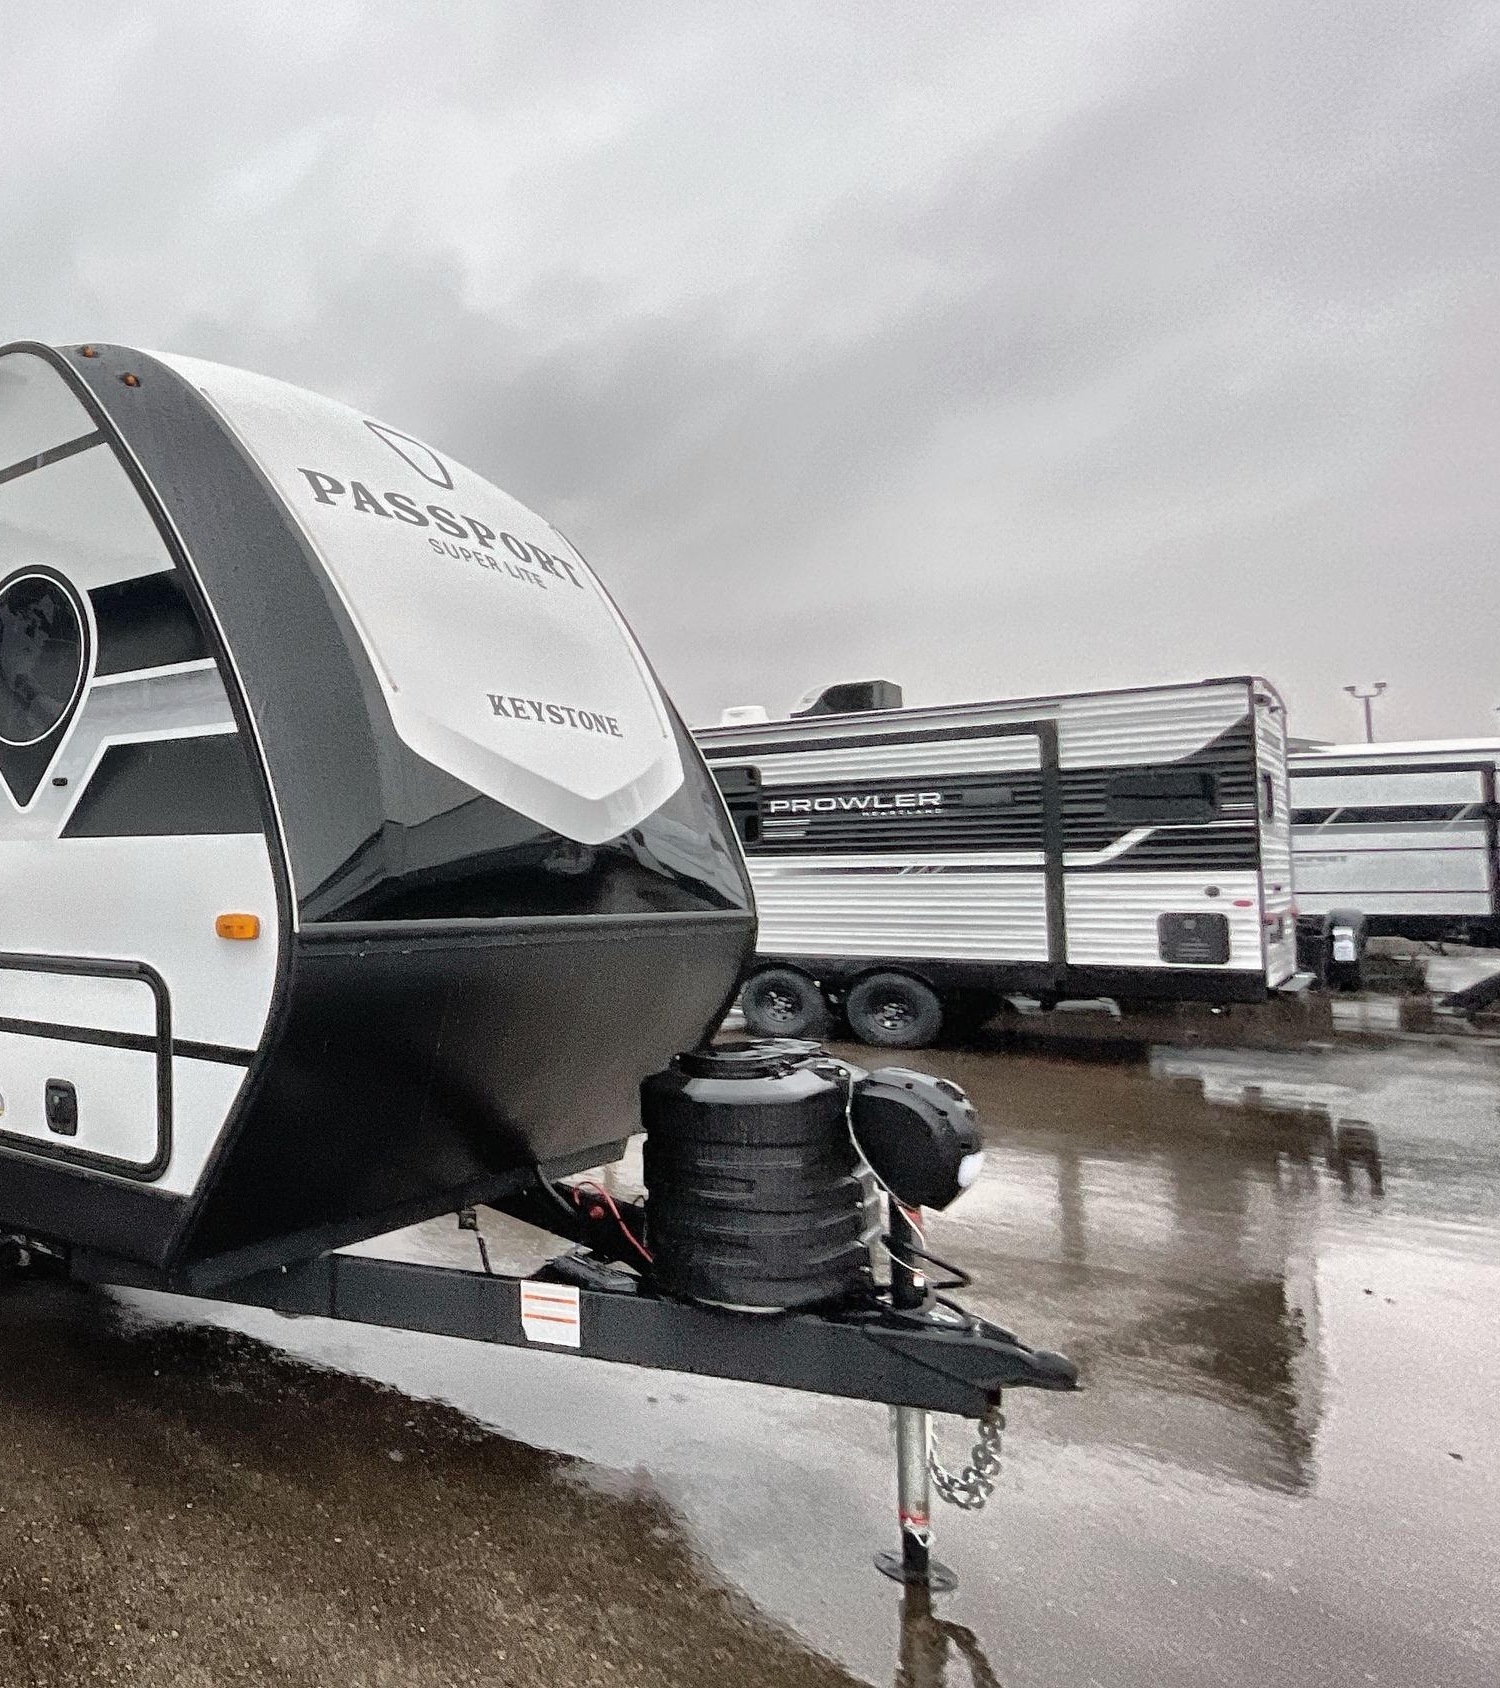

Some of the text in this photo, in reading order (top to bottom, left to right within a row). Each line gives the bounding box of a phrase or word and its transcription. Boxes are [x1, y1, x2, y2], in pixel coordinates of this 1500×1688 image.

[297, 467, 584, 590] PASSPORT
[428, 538, 548, 590] SUPER LITE
[486, 693, 624, 738] KEYSTONE
[770, 791, 942, 813] PROWLER
